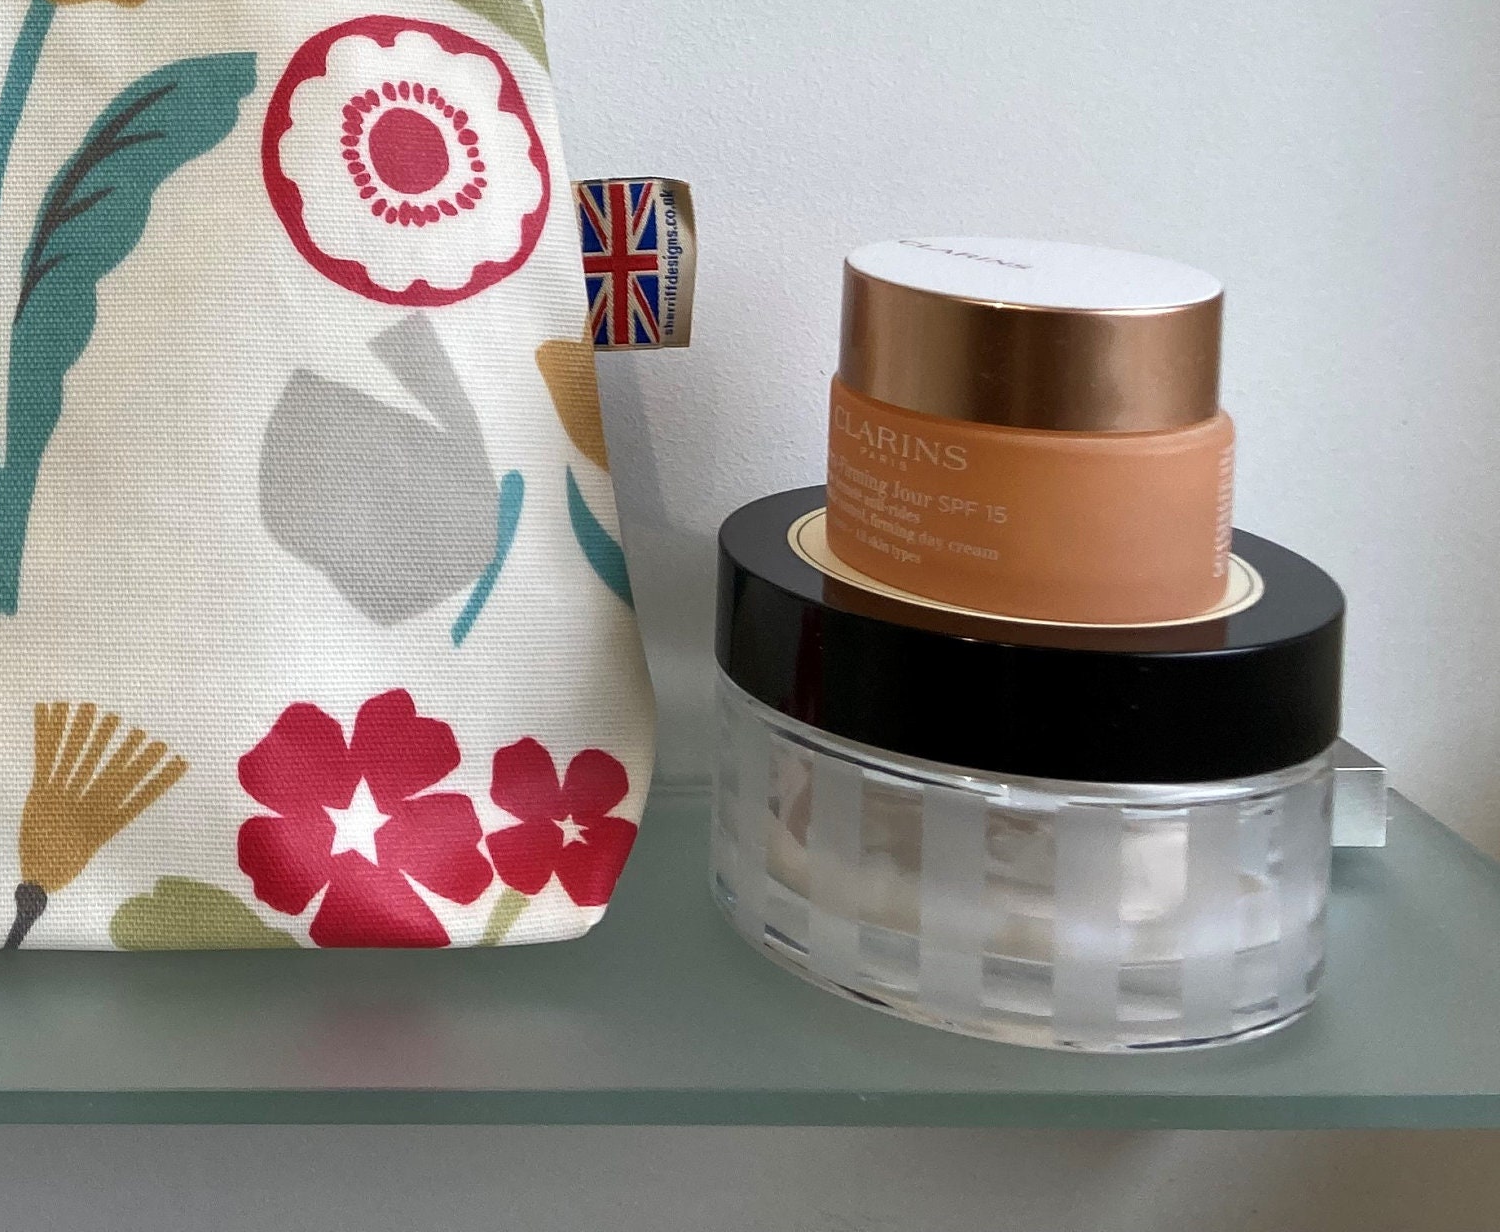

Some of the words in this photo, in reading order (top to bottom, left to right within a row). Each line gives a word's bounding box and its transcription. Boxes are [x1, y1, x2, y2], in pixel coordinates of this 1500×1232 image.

[835, 405, 969, 471] CLARINS
[860, 446, 908, 472] PARIS
[891, 480, 933, 509] Jour
[937, 495, 979, 518] SPF
[985, 503, 1009, 525] 15
[918, 530, 945, 553] day
[948, 541, 1000, 562] cream
